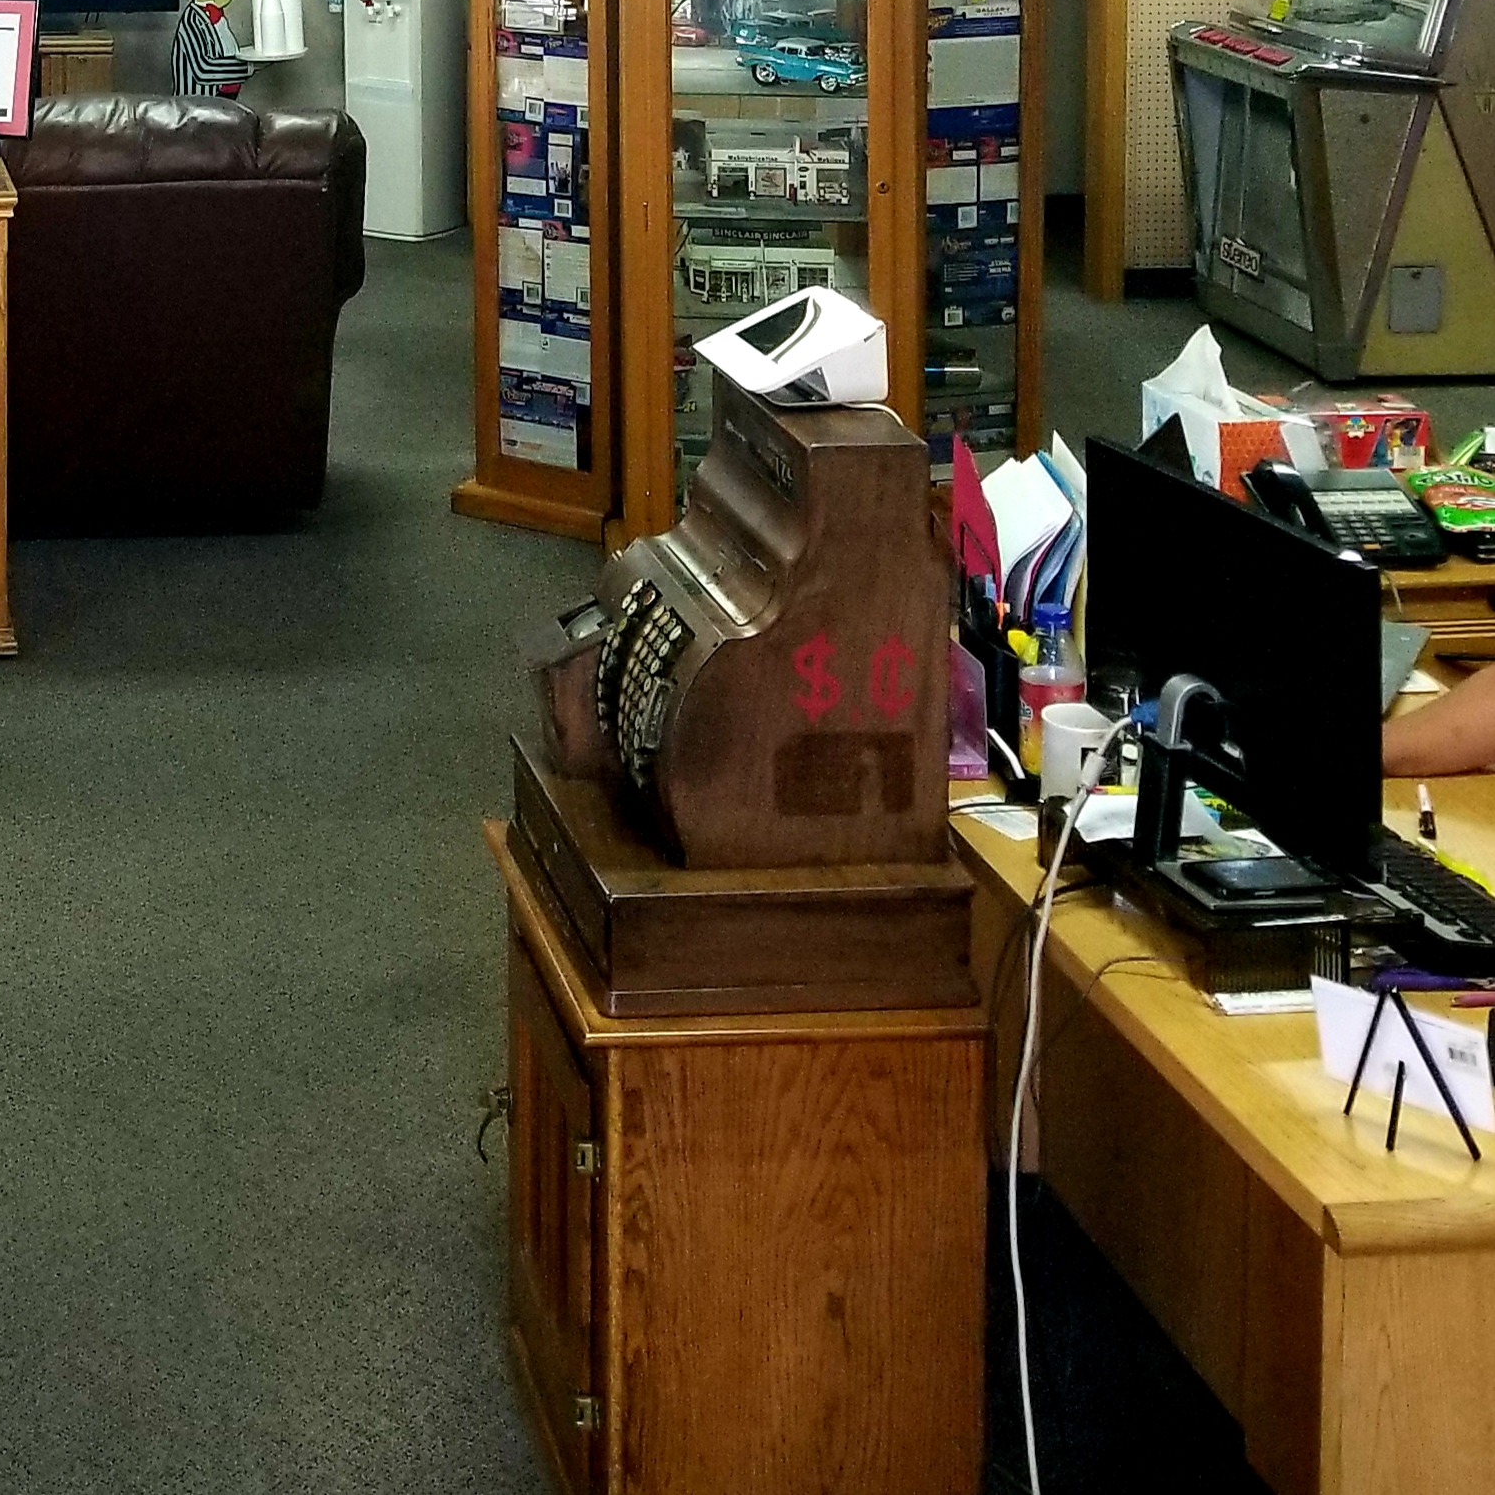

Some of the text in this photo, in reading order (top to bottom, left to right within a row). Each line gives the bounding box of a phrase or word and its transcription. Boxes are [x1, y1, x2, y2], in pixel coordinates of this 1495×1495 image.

[713, 228, 809, 241] SINCLAIR SINCLAIR
[1221, 241, 1258, 272] stereo
